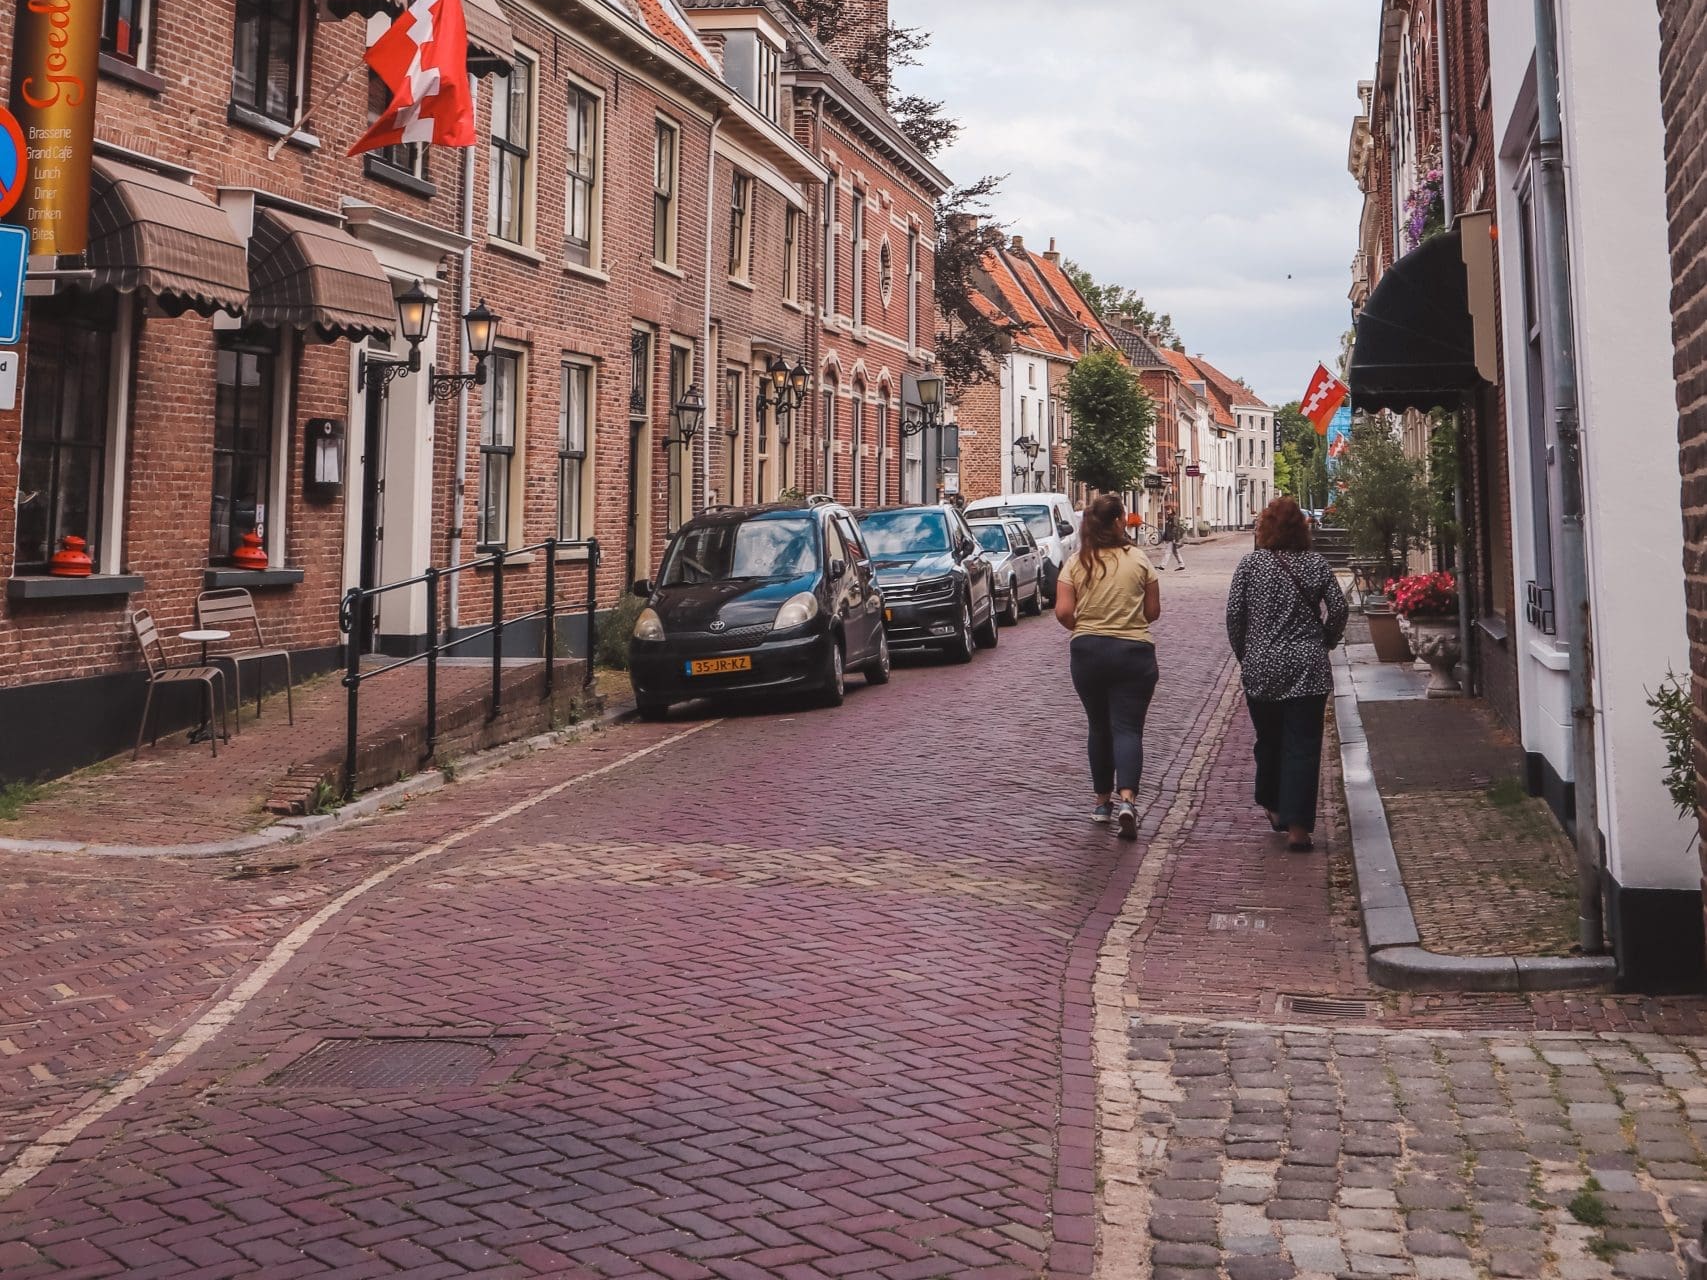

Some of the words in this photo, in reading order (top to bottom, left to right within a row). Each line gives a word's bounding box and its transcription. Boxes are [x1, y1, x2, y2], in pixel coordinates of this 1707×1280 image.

[29, 126, 72, 140] Brasserie
[26, 146, 51, 160] Grand
[52, 145, 73, 162] Café
[34, 166, 61, 180] Lunch
[34, 186, 57, 200] Diner
[28, 207, 62, 221] Drinken
[32, 227, 55, 241] Bites
[696, 658, 746, 672] 35-JR-KZ
